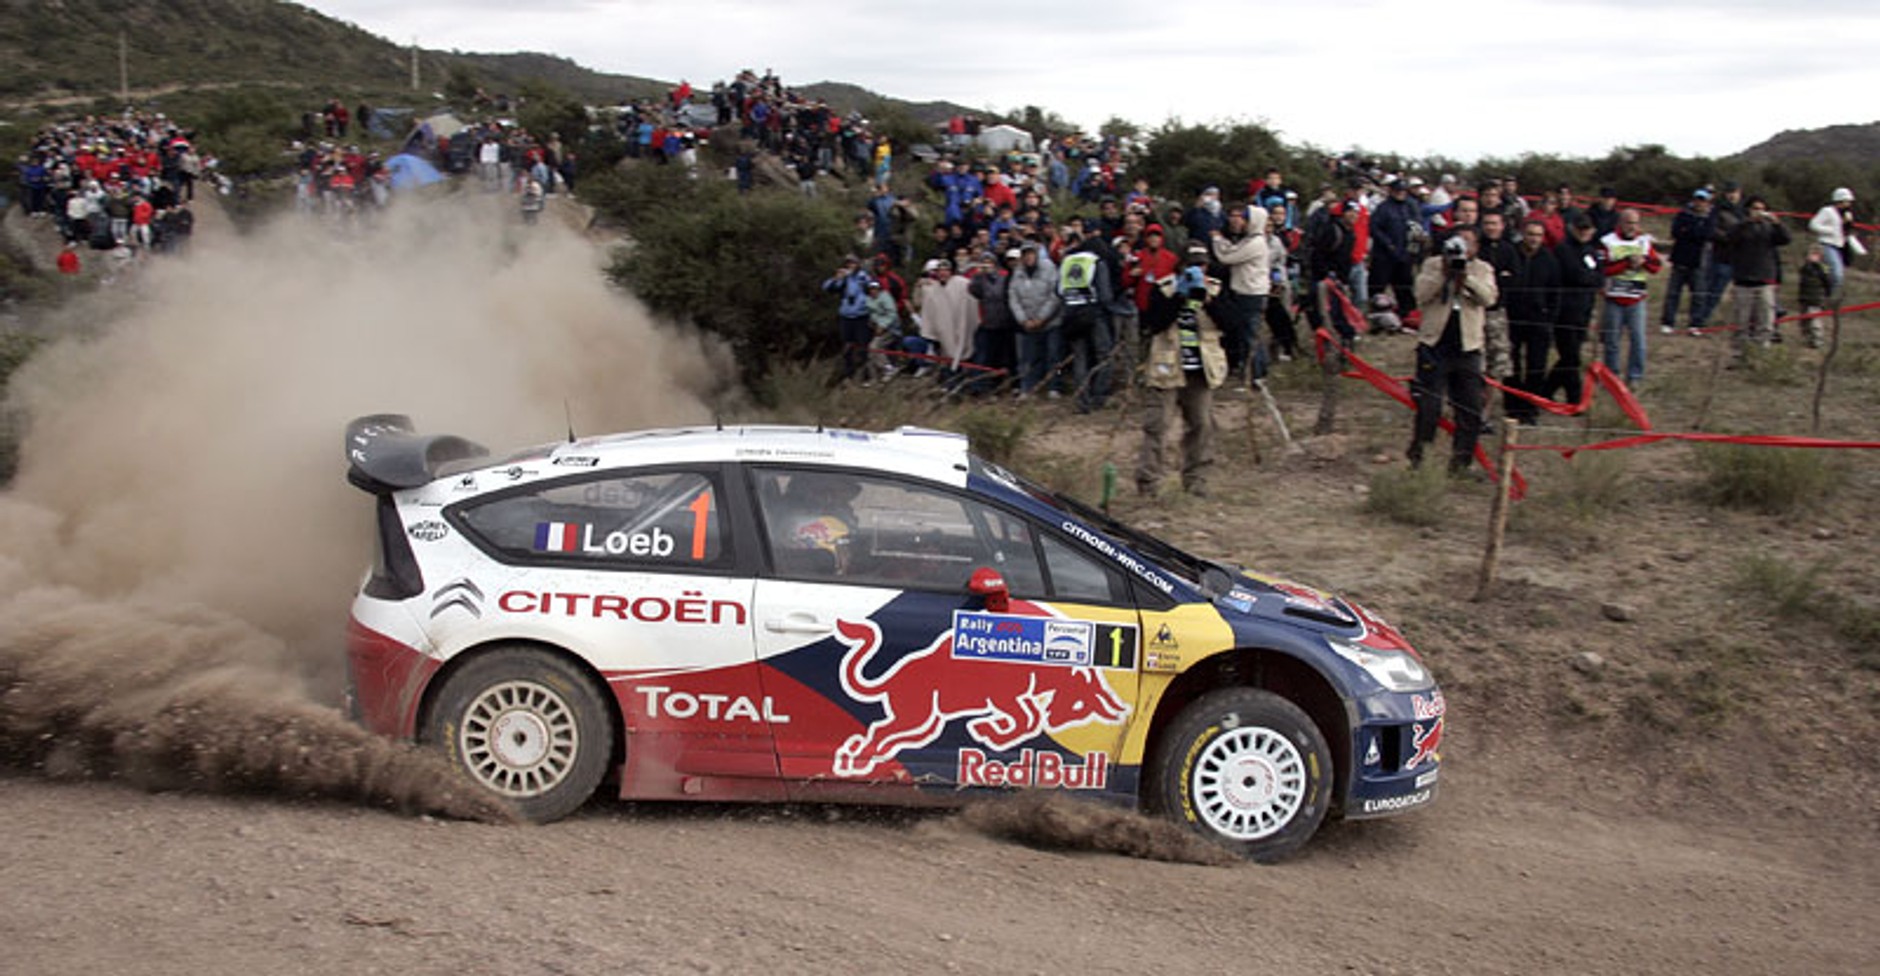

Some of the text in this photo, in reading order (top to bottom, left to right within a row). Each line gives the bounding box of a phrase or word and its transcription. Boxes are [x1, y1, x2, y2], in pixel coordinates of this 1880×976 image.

[583, 523, 674, 557] Loeb
[687, 490, 711, 560] 1
[956, 632, 1042, 655] Argentina
[960, 617, 993, 634] Rally
[1109, 627, 1122, 668] 1
[958, 748, 1107, 789] Red Bull
